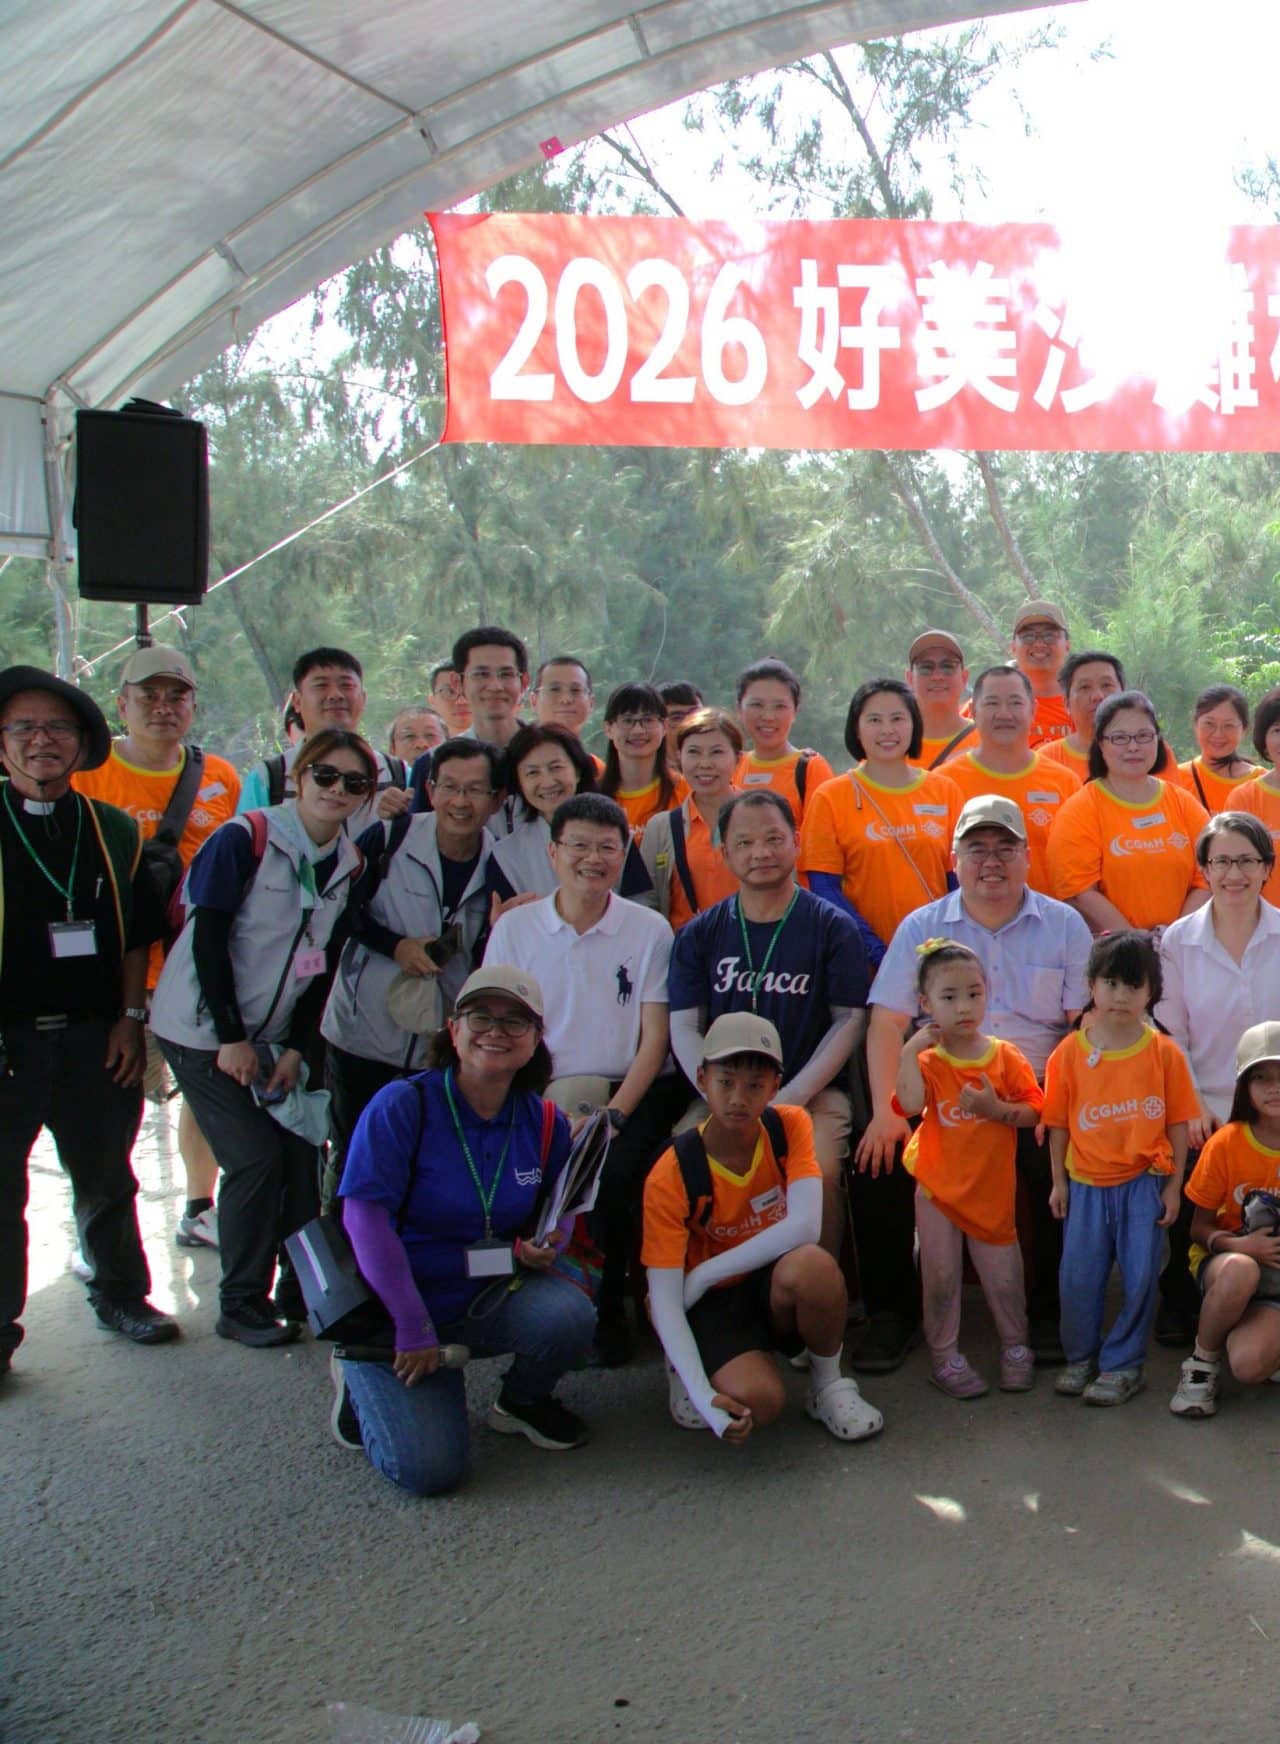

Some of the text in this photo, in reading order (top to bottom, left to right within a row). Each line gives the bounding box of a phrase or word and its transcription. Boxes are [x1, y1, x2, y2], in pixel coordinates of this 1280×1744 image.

[485, 254, 769, 405] 2026
[714, 956, 811, 996] Fanca
[1089, 1100, 1138, 1120] CGMH
